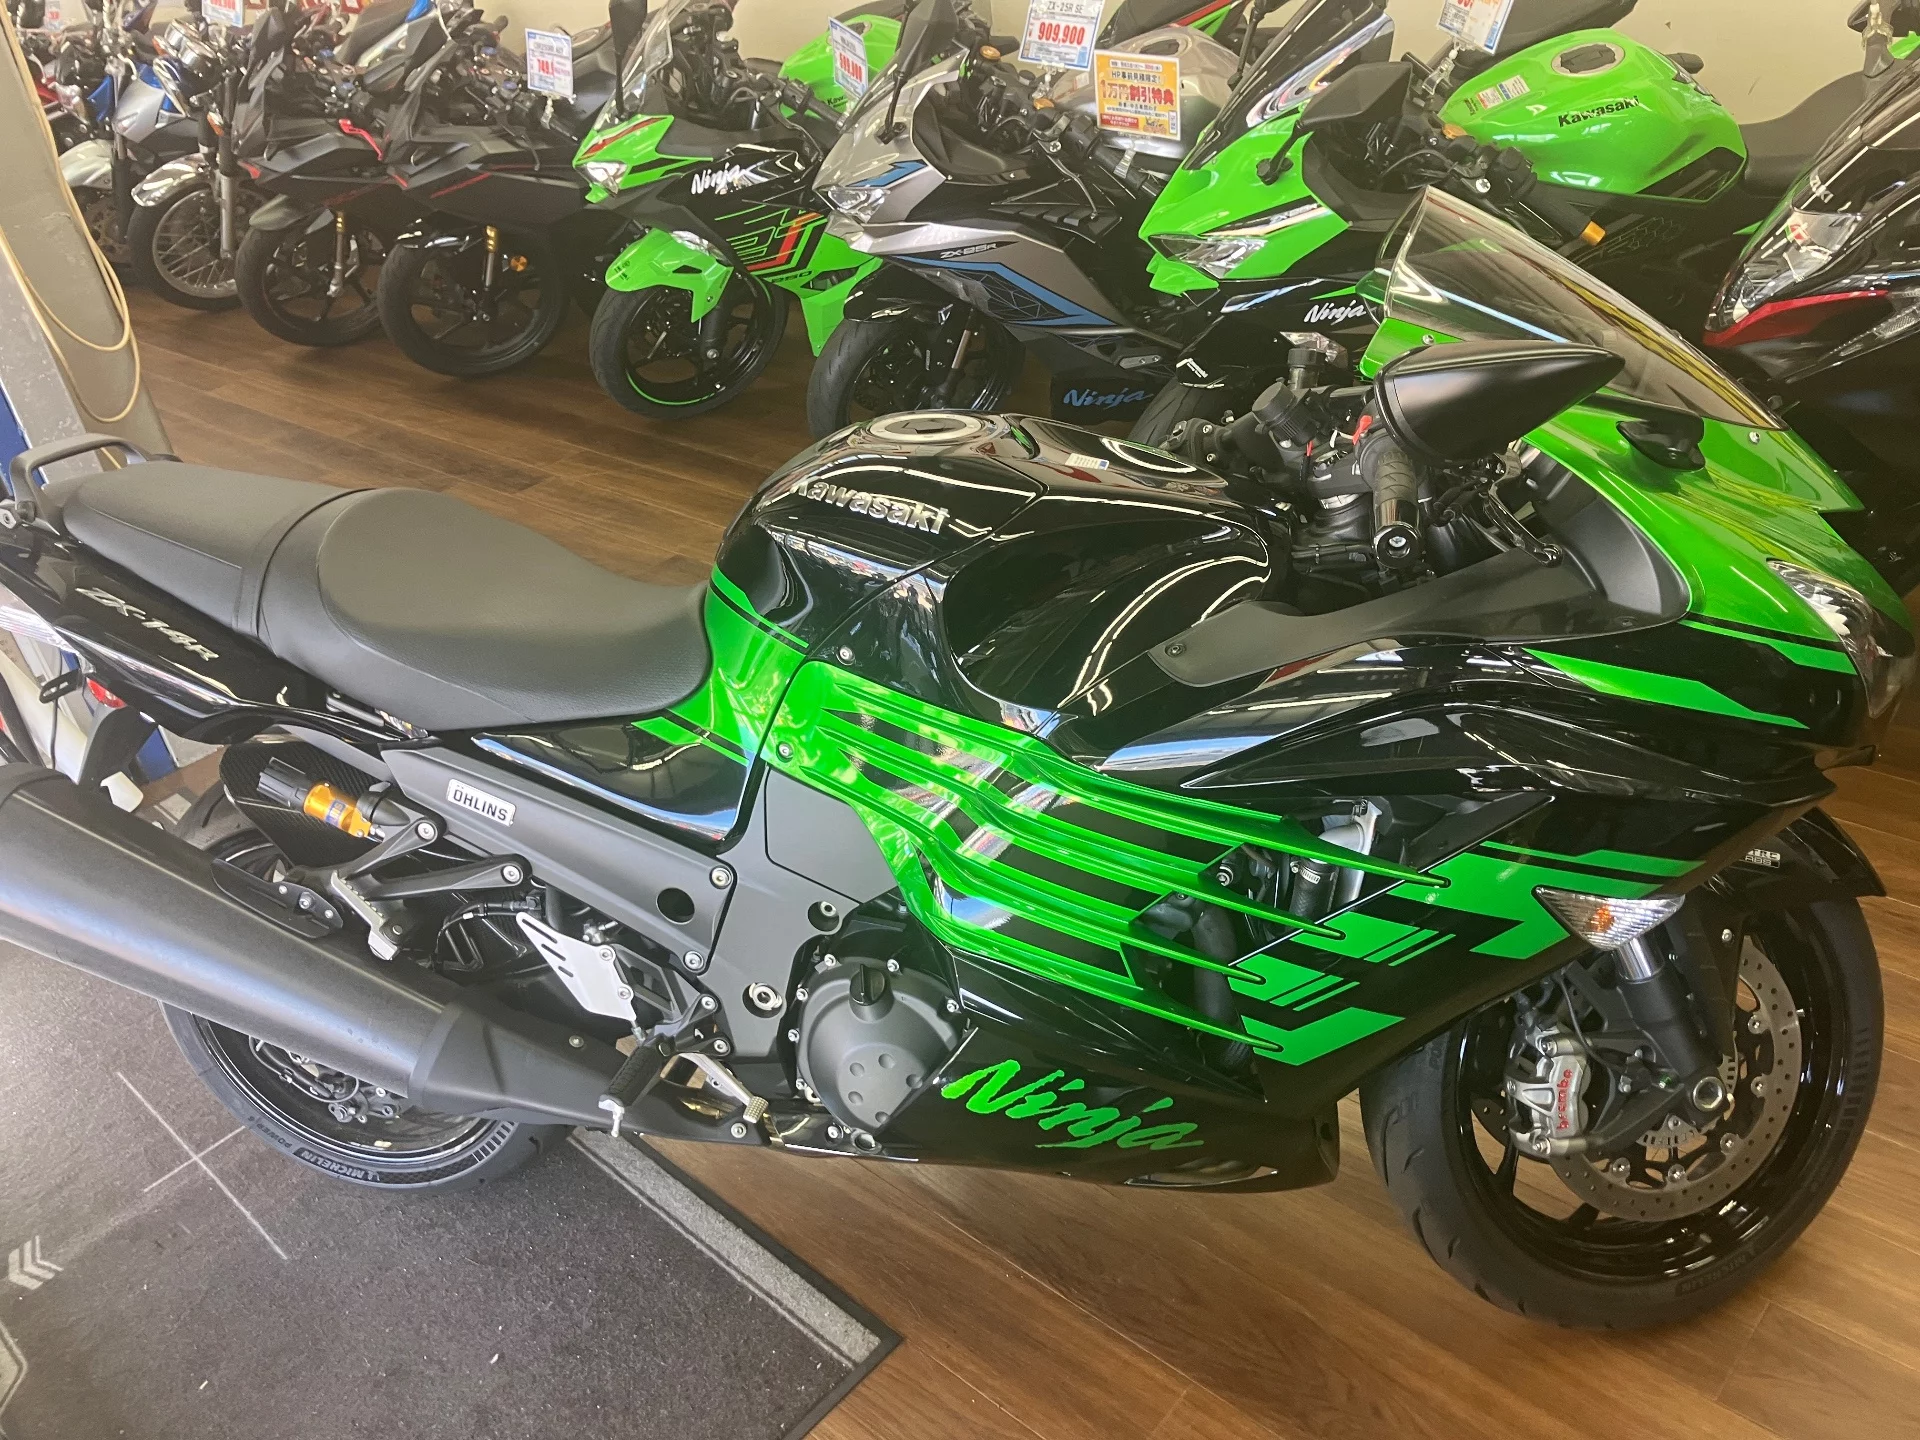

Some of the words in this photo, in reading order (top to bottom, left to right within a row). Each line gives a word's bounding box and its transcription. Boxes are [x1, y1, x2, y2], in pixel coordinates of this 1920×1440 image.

[1038, 21, 1085, 46] 909,900
[1100, 79, 1175, 106] 1万円割引特典
[1557, 95, 1640, 128] Kawasaki
[690, 161, 741, 195] Ninja
[940, 243, 998, 259] ZX-25R
[1303, 299, 1367, 326] Ninja
[1062, 387, 1154, 411] Ninja
[74, 587, 220, 662] ZX-14R
[453, 783, 509, 821] ÖHLINS
[940, 1058, 1205, 1151] Ninja
[1556, 1068, 1573, 1131] brembo
[256, 1122, 293, 1149] POWER
[301, 1150, 366, 1180] MICHELIN
